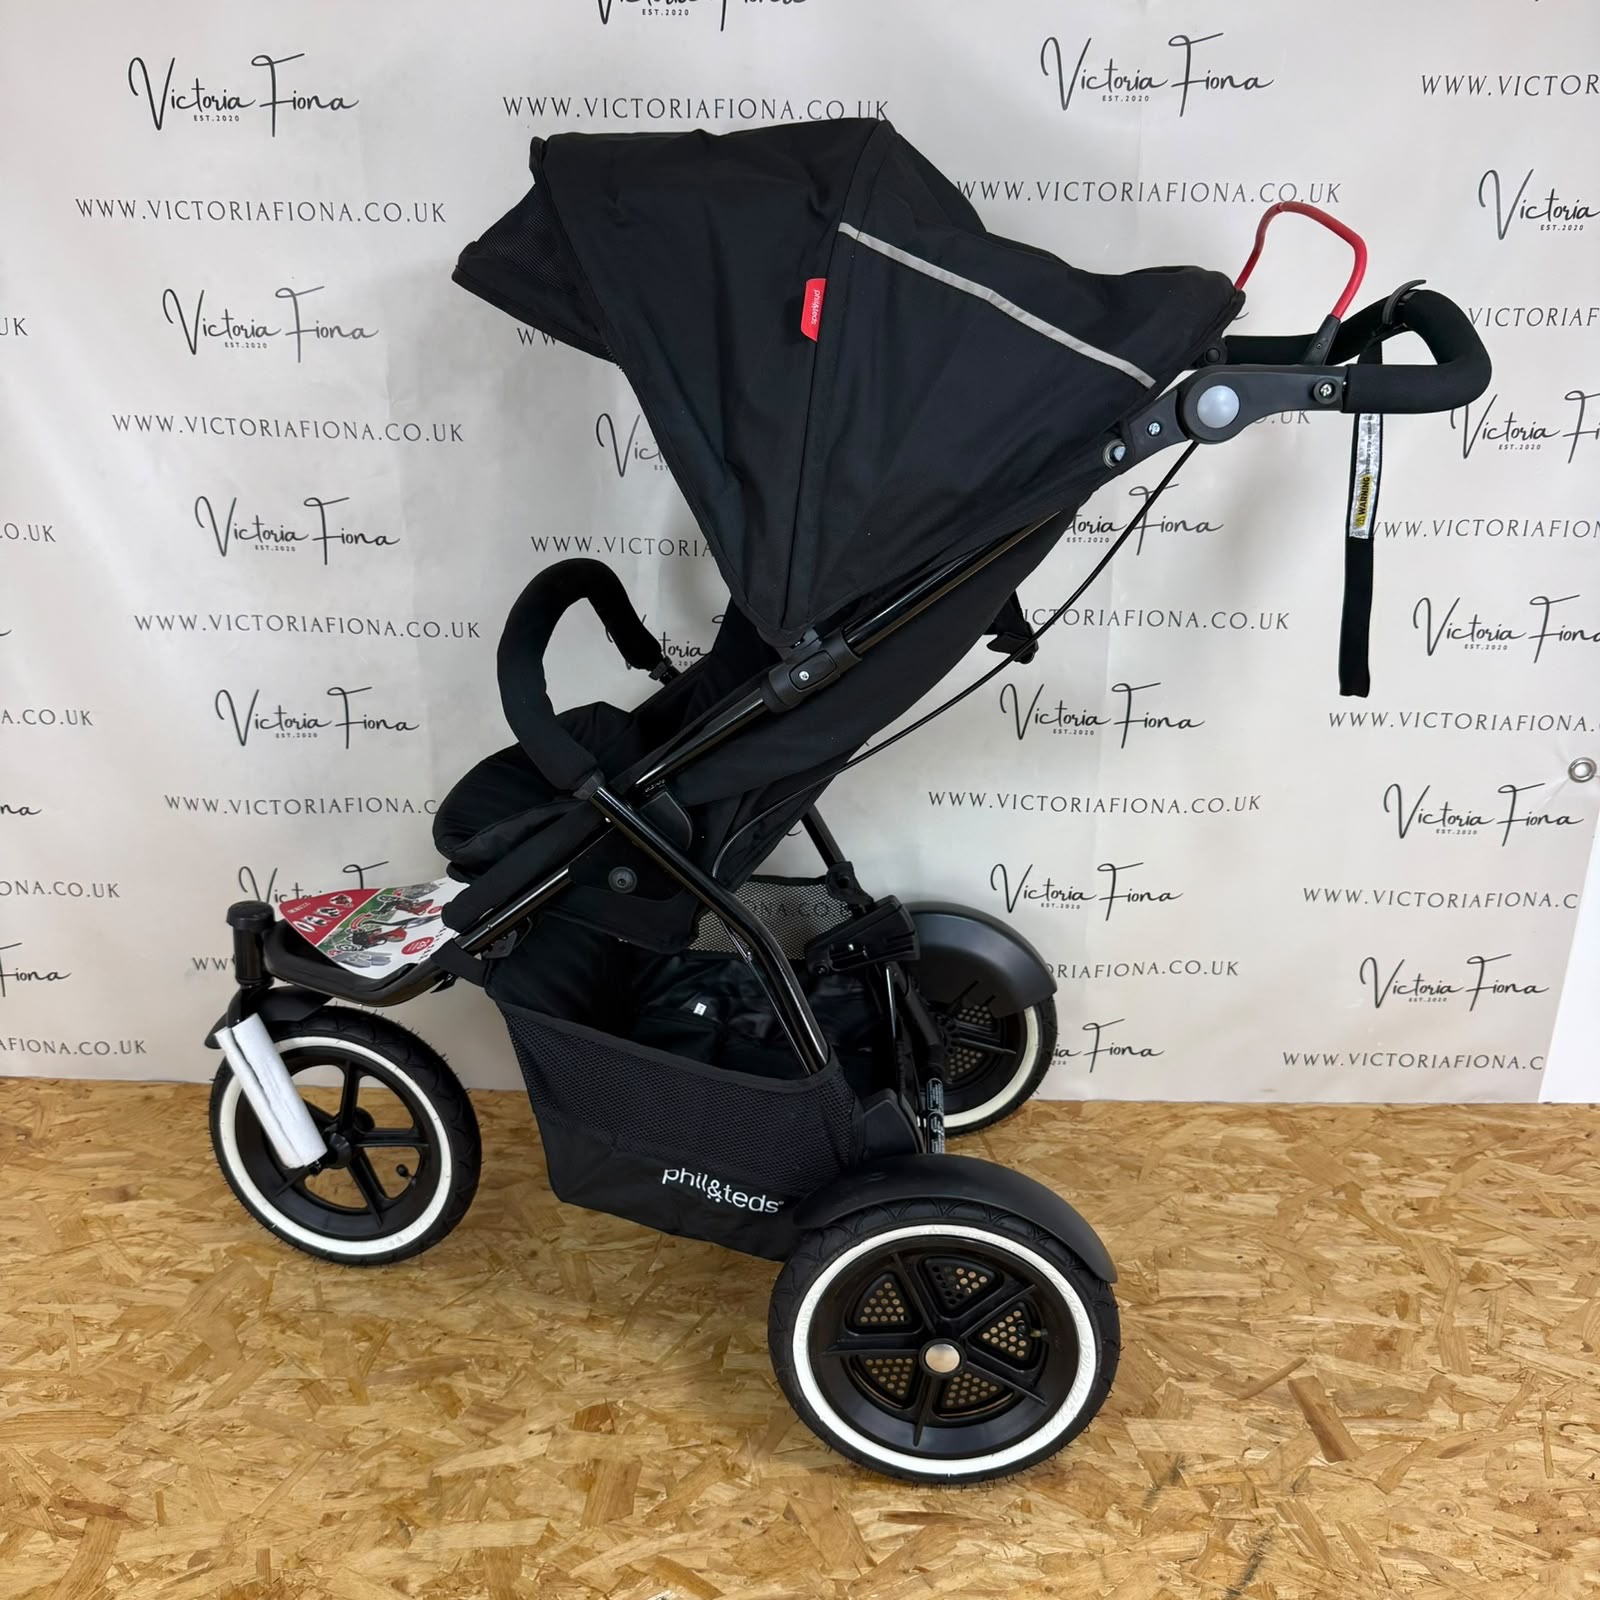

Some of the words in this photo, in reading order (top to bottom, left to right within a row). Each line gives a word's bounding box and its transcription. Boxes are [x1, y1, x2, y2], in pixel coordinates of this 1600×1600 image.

[128, 57, 256, 131] Victoria
[251, 53, 359, 137] Fiona
[1040, 37, 1168, 111] Victoria
[1168, 33, 1274, 117] Fiona
[502, 96, 889, 121] WWW.VICTORIAFIONA.COUK
[1102, 94, 1149, 102] EST.2020
[75, 199, 446, 223] WWW.VICTORIAFIONA.CO.UK
[956, 181, 1341, 203] WWW.VICTORIAFIONA.CO.UK
[1478, 169, 1600, 240] Victoria
[162, 289, 282, 355] Victoria
[275, 286, 379, 363] Fiona
[1468, 307, 1600, 327] VICTORIAF
[112, 414, 464, 442] WWW.VICTORIAFIONA.CO.UK
[1449, 394, 1561, 459] Victoria
[1357, 476, 1371, 515] WARNING
[194, 496, 309, 557] Victoria
[303, 497, 400, 565] Fiona
[1128, 483, 1224, 556] Fiona
[531, 535, 713, 557] WWW.VICTORIA
[134, 614, 480, 638] WWW.VICTORIAFIONA.CO.UK
[1413, 597, 1527, 656] Victoria
[215, 689, 332, 747] Victoria
[327, 687, 420, 749] Fiona
[1000, 683, 1111, 740] Victoria
[1111, 682, 1205, 749] Fiona
[1329, 712, 1600, 732] WWW.VICTORIAFIONA.
[164, 795, 436, 815] WWW.VICTORIAFIONA.C
[928, 792, 1261, 814] WWW.VICTORIAFIONA.CO.UK
[1383, 783, 1495, 839] Victoria
[1496, 783, 1584, 847] Fiona
[990, 864, 1097, 913] Victoria
[1097, 862, 1183, 921] Fiona
[1303, 888, 1579, 909] WWW.VICTORIAFIONA.C
[1359, 957, 1464, 1009] Victoria
[1465, 954, 1550, 1012] Fiona
[1082, 1019, 1164, 1073] Fiona
[1283, 1052, 1544, 1070] WWW.VICTORIAFIONA.C
[662, 1168, 780, 1213] phil&teds
